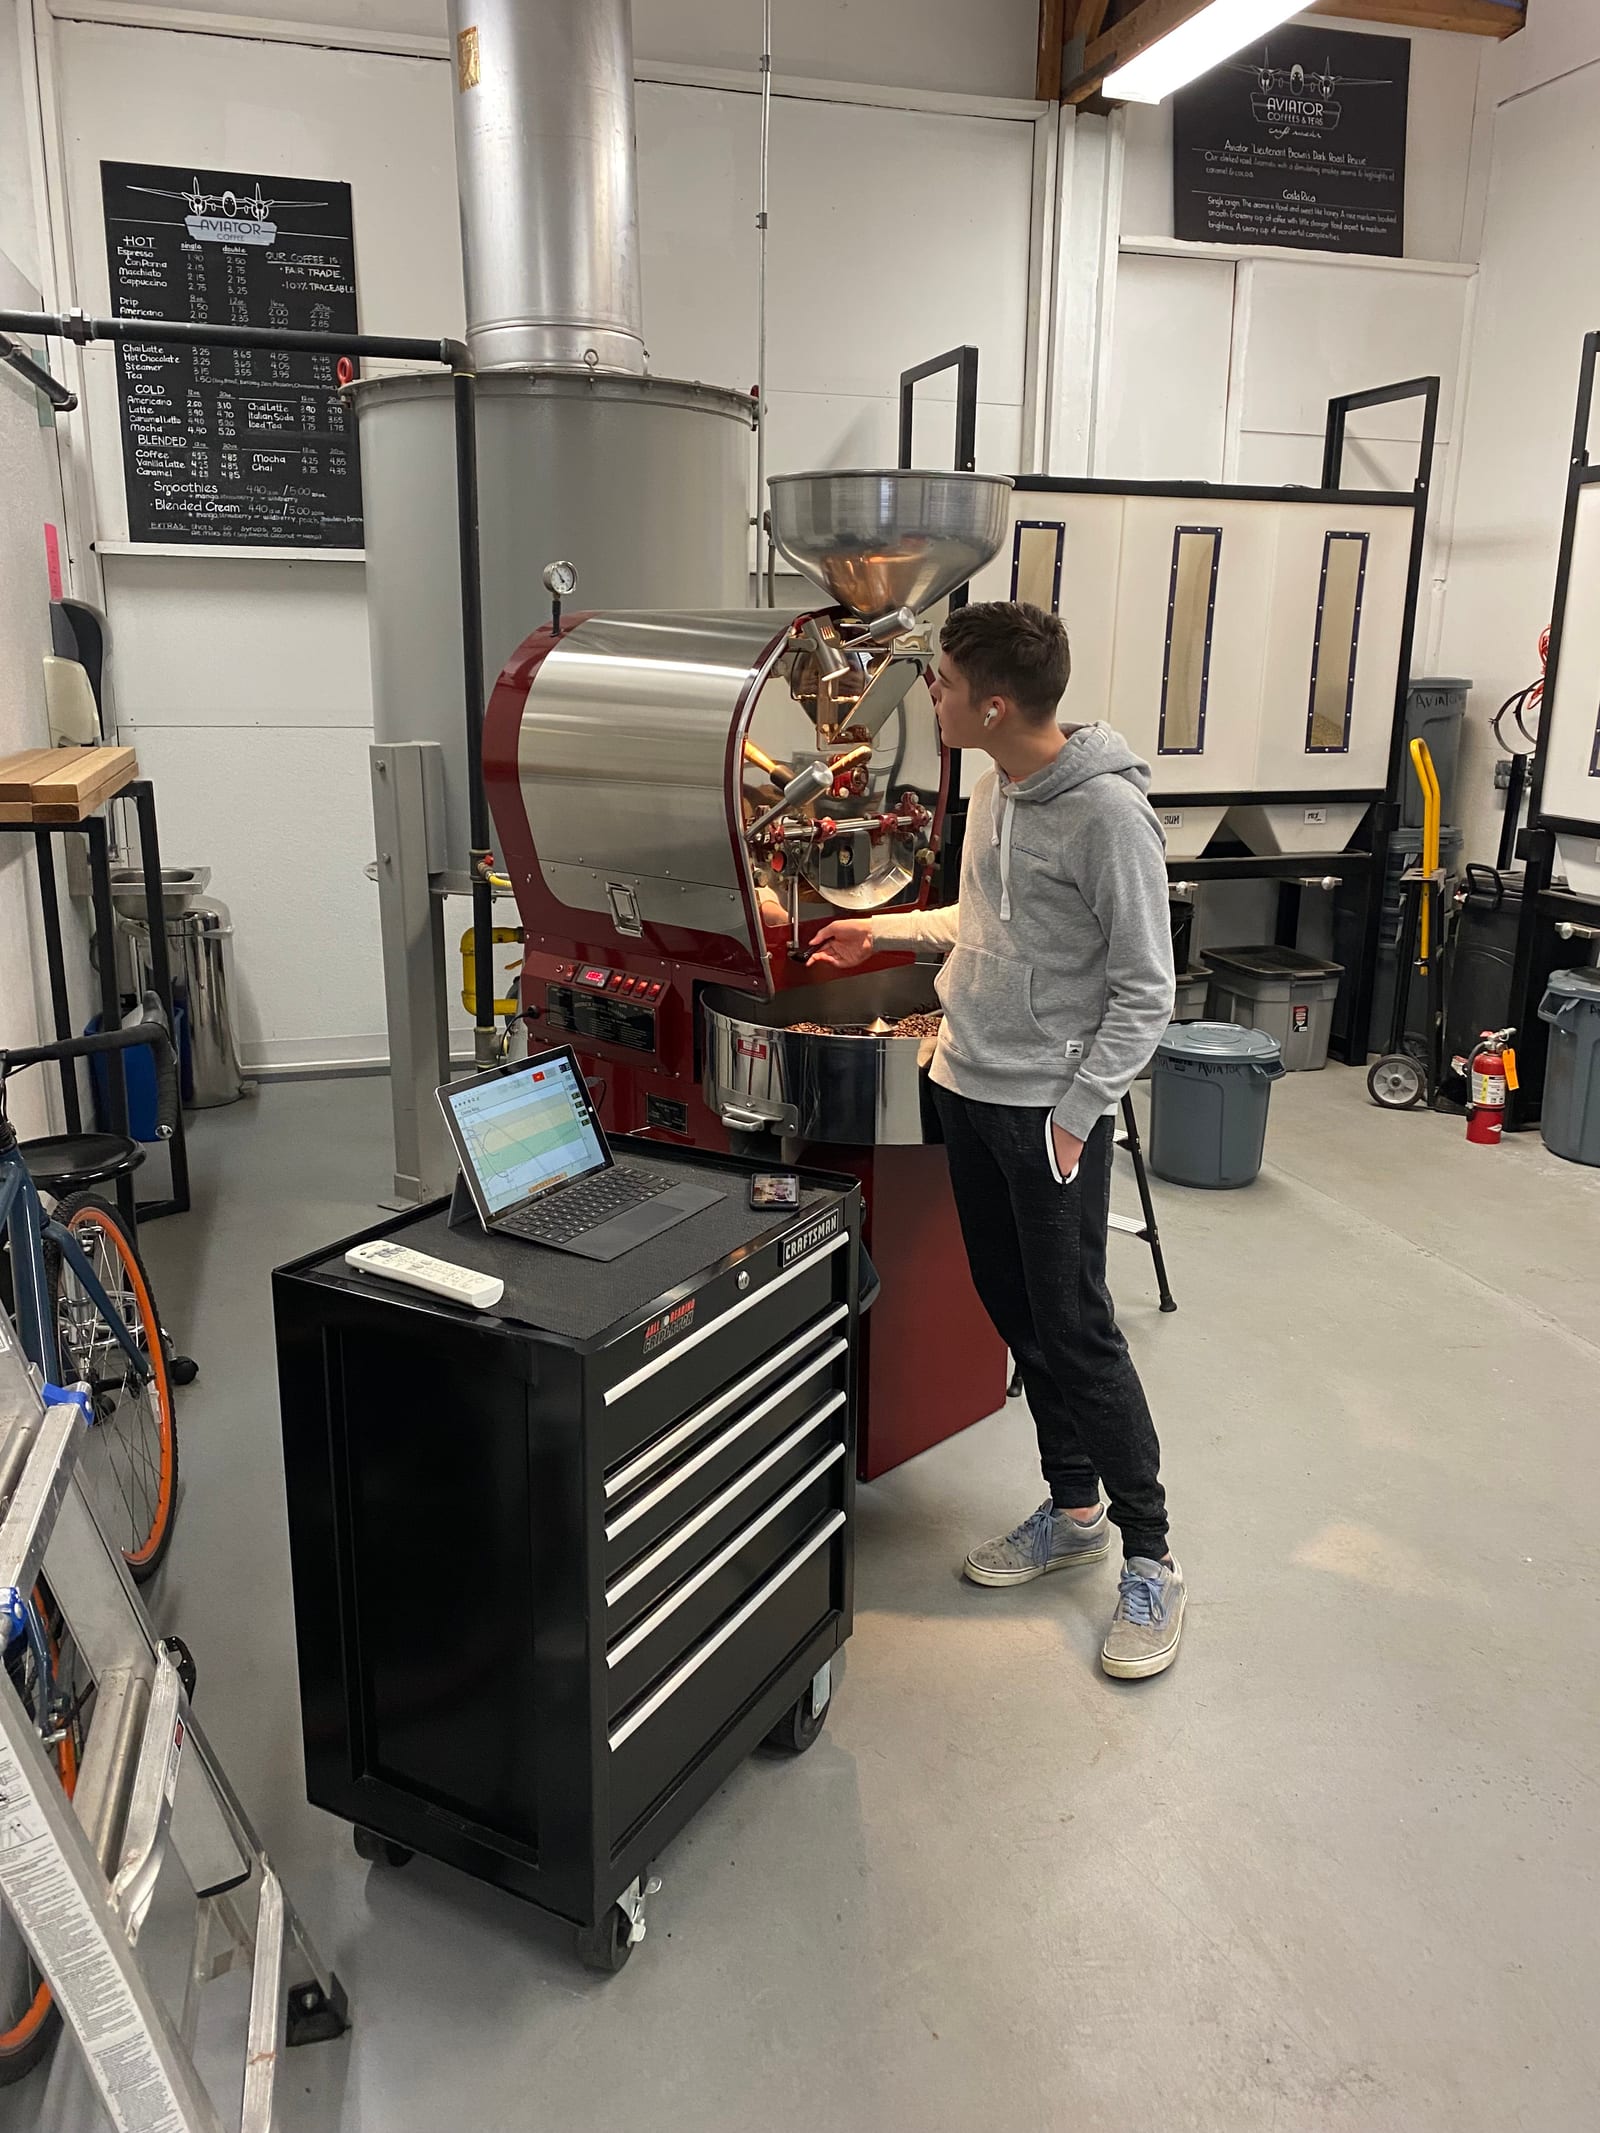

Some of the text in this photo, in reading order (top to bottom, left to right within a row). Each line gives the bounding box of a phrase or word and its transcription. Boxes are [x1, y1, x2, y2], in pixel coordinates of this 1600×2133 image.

[1267, 97, 1323, 116] AVIATOR
[1308, 117, 1323, 126] TEAS
[1205, 151, 1217, 161] Our
[1224, 139, 1248, 152] Aviator
[1313, 150, 1326, 161] Dark
[1329, 152, 1345, 163] Roast
[1282, 189, 1316, 203] Costa Rica
[1208, 196, 1223, 208] Single
[1242, 199, 1252, 208] The
[200, 219, 261, 235] AVIATOR
[123, 236, 155, 249] HOT
[216, 233, 245, 241] COFFEE
[181, 241, 246, 253] single double
[117, 247, 154, 260] Espresso
[265, 251, 286, 261] OUR
[290, 253, 324, 265] COFFEE
[141, 259, 167, 268] Panna
[119, 267, 161, 278] Macchiato
[120, 276, 167, 287] Cappuccino
[309, 282, 355, 294] TRACEABLE
[120, 296, 139, 307] Drip
[120, 306, 163, 317] Americano
[122, 344, 140, 353] Chai
[141, 344, 164, 354] Latte
[124, 353, 139, 362] Hot
[140, 353, 180, 363] Chocolate
[125, 362, 163, 371] Steamer
[125, 371, 143, 380] Tea
[135, 384, 165, 394] COLD
[127, 395, 172, 406] Americano
[129, 405, 154, 414] Latte
[248, 402, 266, 411] Chai
[267, 403, 289, 413] Latte
[130, 415, 163, 423] Caramel
[248, 411, 273, 420] Italian
[273, 413, 295, 421] Soda
[130, 423, 163, 432] Mocha
[187, 426, 207, 434] 4.40
[248, 420, 265, 429] Iced
[266, 421, 282, 429] Tea
[138, 434, 187, 447] BLENDED
[135, 449, 170, 459] Coffee
[253, 454, 286, 464] Mocha
[135, 458, 164, 467] Vanilla
[164, 460, 186, 469] Latte
[251, 463, 273, 472] Chai
[136, 467, 173, 478] Caramel
[153, 480, 218, 493] Smoothies
[155, 499, 202, 511] Blended
[205, 501, 240, 512] Cream
[784, 1216, 838, 1260] CRAFTSMAN
